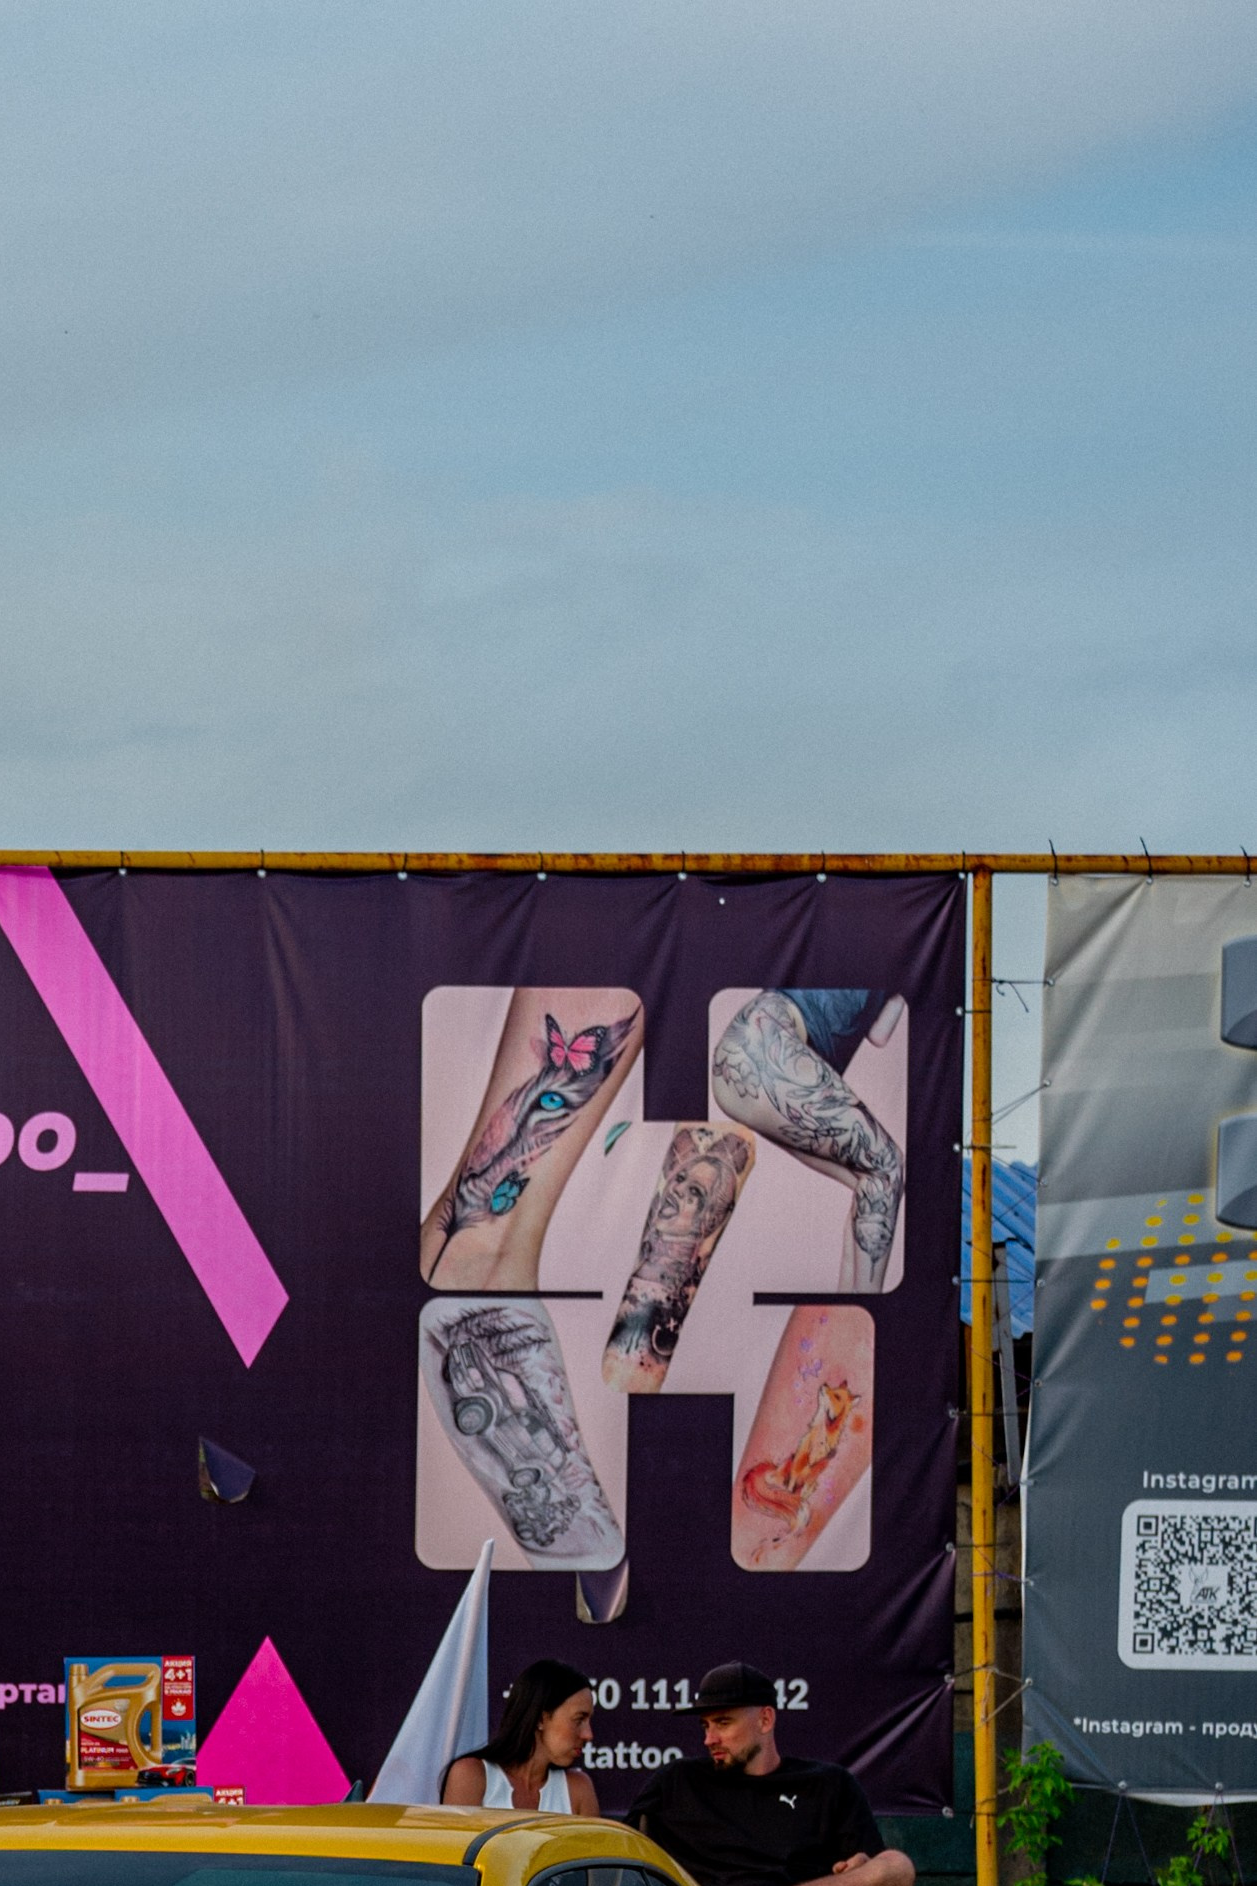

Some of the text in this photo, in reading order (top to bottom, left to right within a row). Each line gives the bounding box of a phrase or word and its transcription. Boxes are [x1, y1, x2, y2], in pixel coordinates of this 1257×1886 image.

[1143, 1470, 1257, 1494] Instagram
[164, 1668, 192, 1682] 4+1
[83, 1715, 120, 1723] SINTEC
